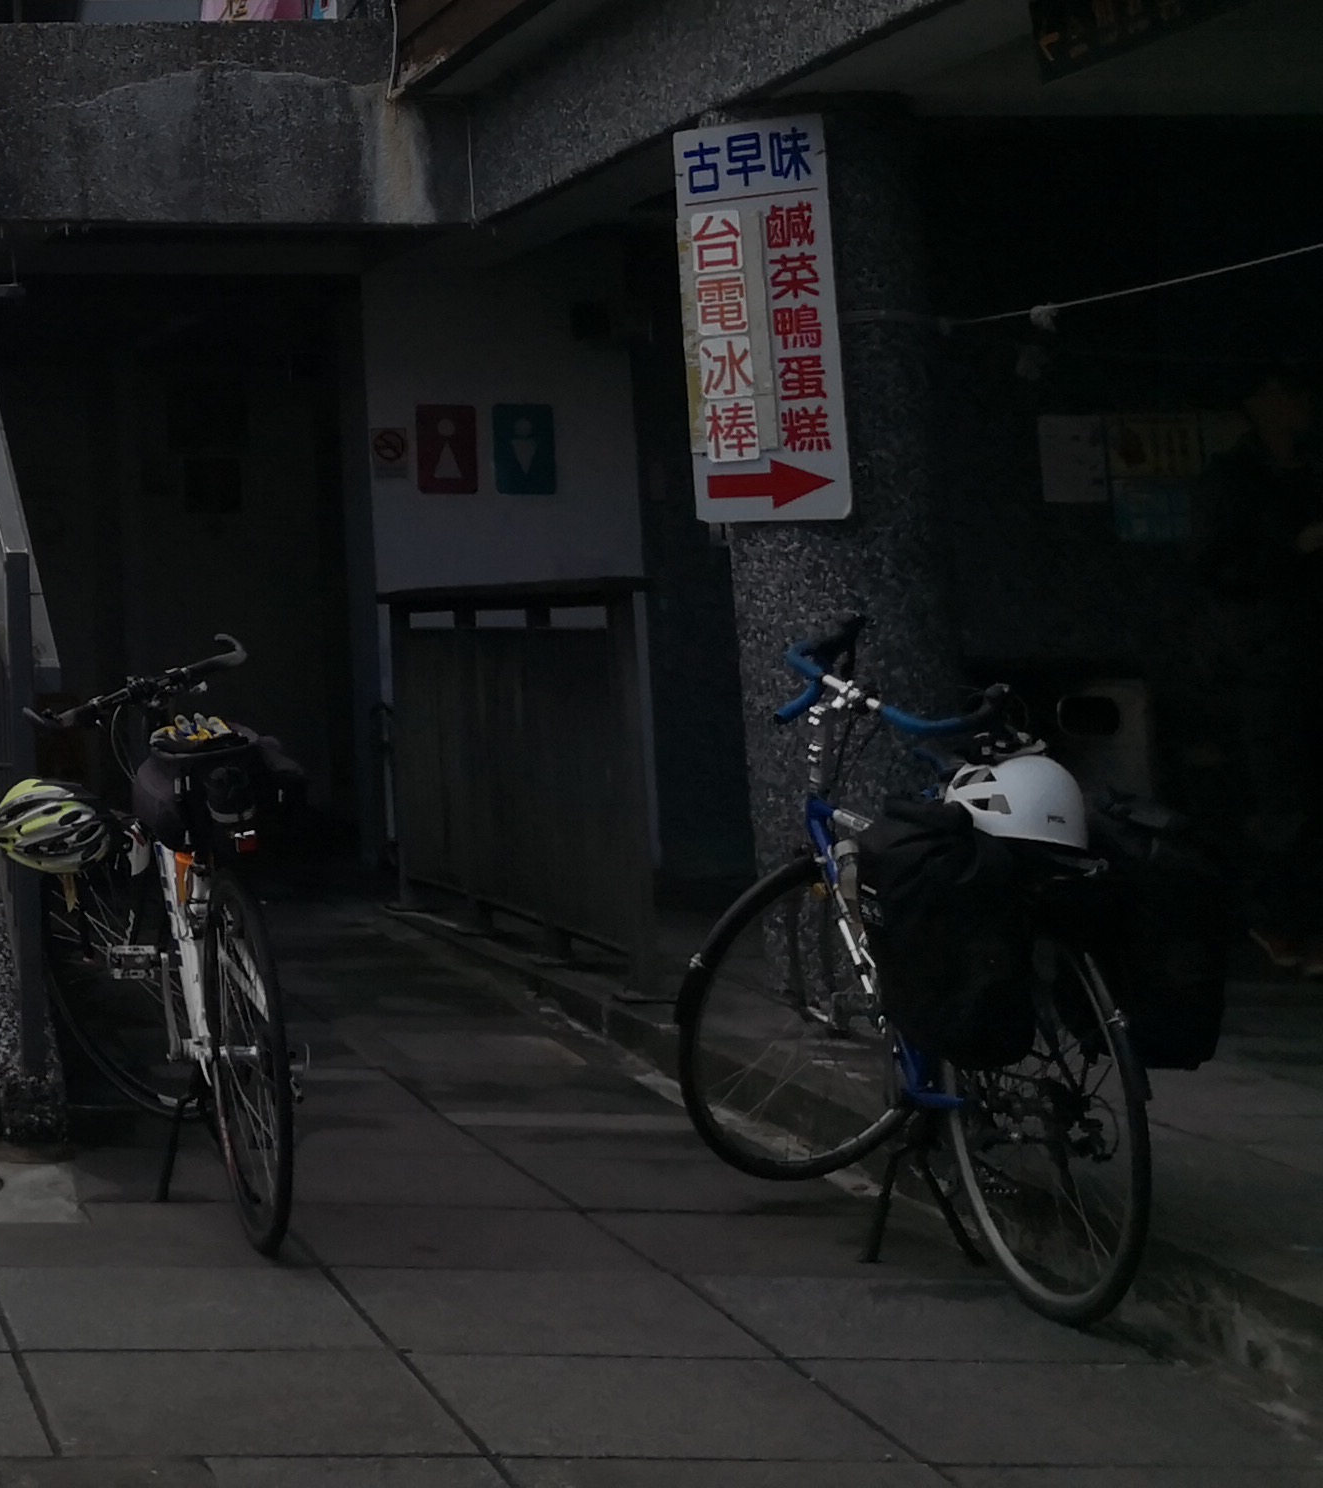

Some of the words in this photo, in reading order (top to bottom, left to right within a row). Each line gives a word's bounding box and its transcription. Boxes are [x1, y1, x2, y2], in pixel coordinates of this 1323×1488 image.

[684, 127, 812, 194] 古早味
[693, 214, 758, 458] 台電冰棒
[765, 201, 834, 452] 鹹菜鴨蛋糕
